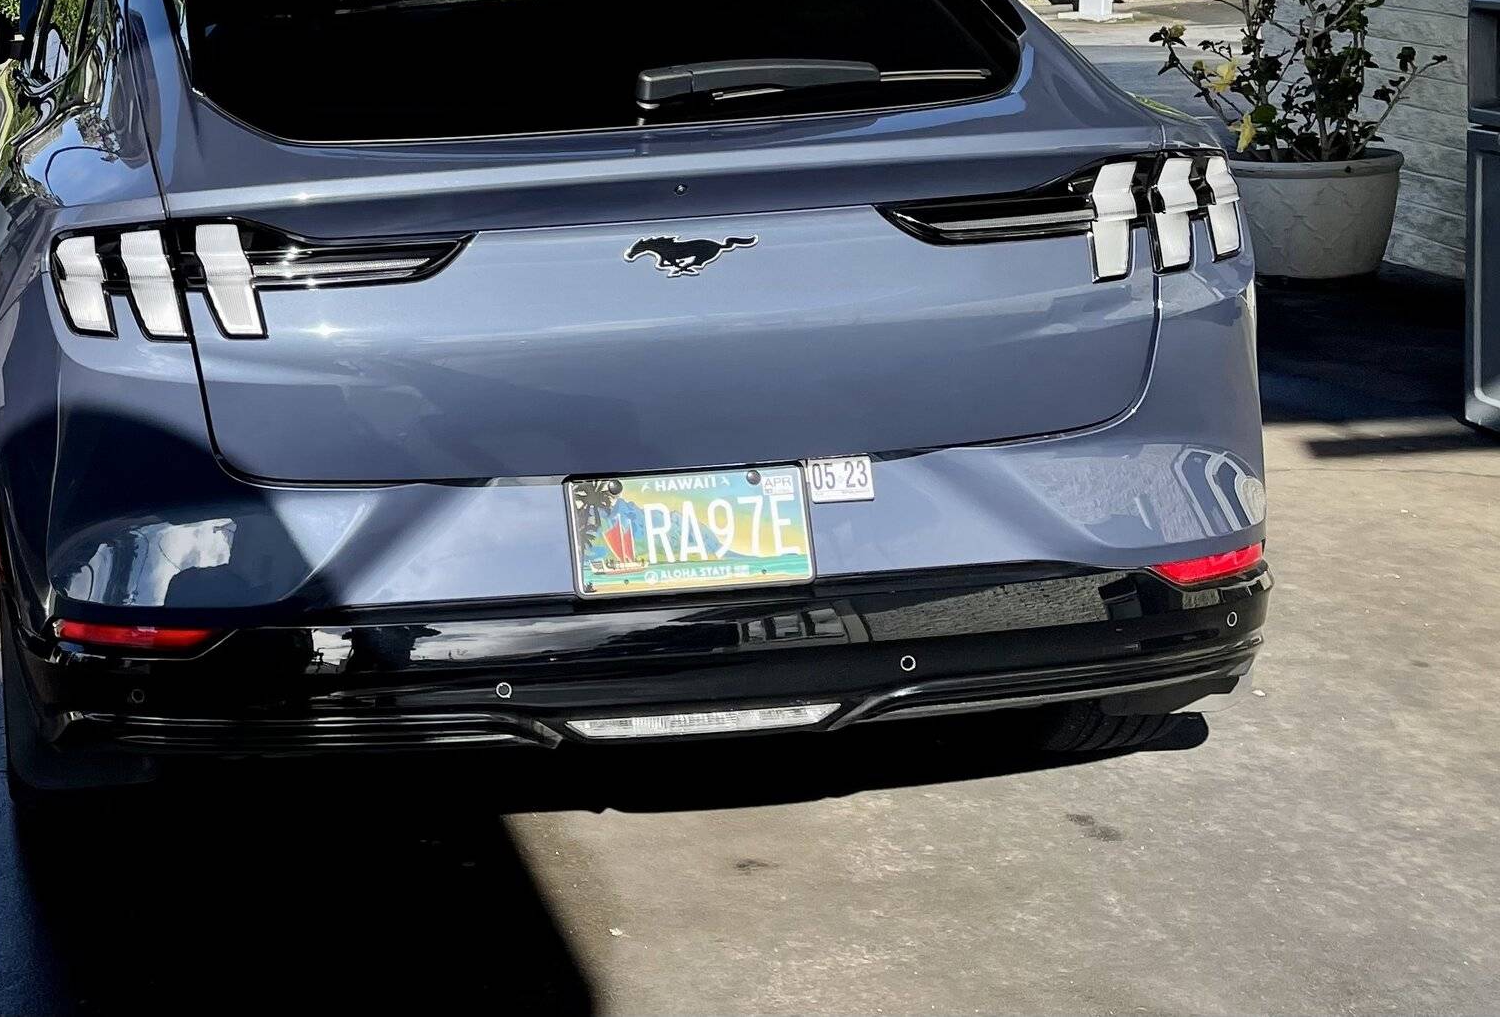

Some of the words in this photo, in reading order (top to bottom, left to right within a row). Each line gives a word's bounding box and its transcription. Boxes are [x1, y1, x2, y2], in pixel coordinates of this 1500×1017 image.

[764, 476, 792, 488] APR
[812, 462, 836, 491] 05
[844, 460, 868, 489] 23
[644, 495, 801, 564] RA97E
[660, 567, 698, 580] ALOHA
[700, 565, 732, 577] STATE
